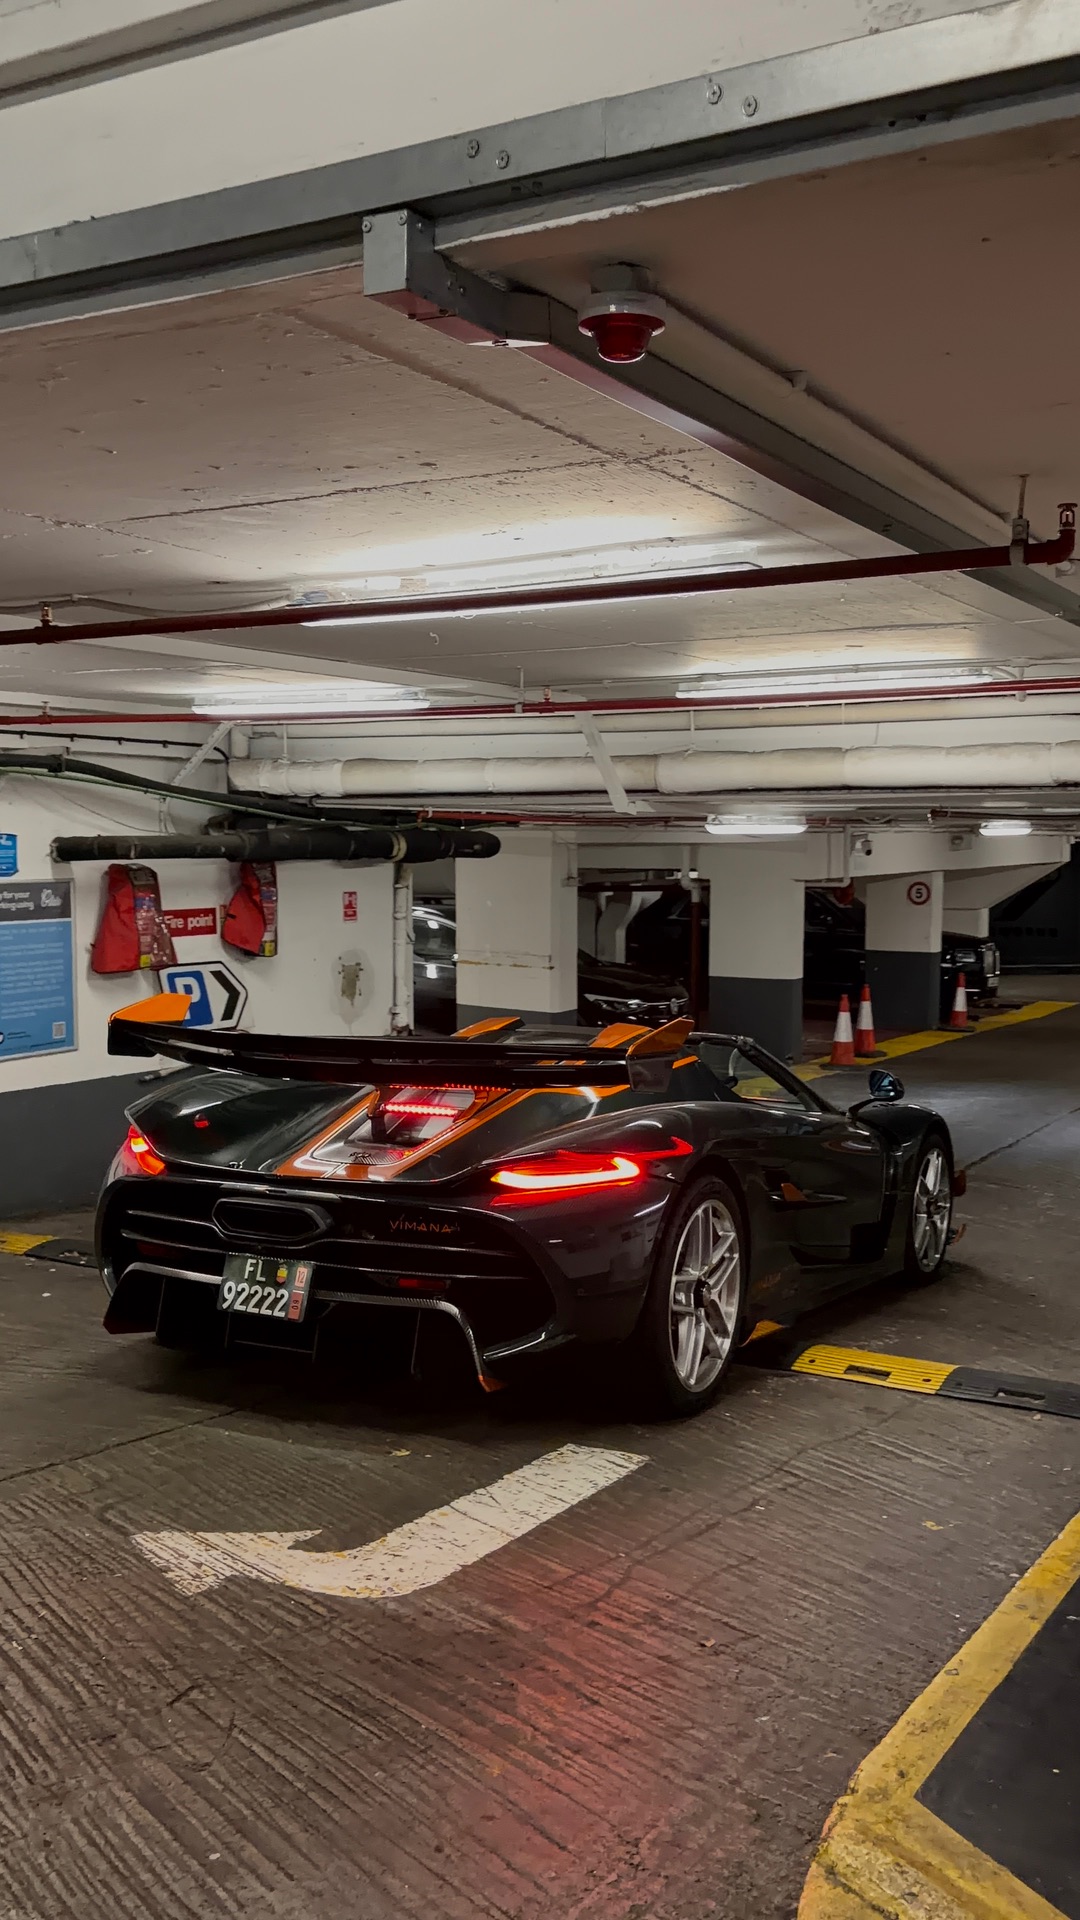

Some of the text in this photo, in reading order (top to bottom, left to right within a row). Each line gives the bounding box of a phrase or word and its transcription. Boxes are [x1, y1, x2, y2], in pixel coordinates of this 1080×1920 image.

[914, 888, 923, 899] 5
[164, 913, 214, 931] Fire point
[174, 976, 202, 1020] P
[244, 1258, 266, 1282] FL
[222, 1281, 289, 1318] 92222
